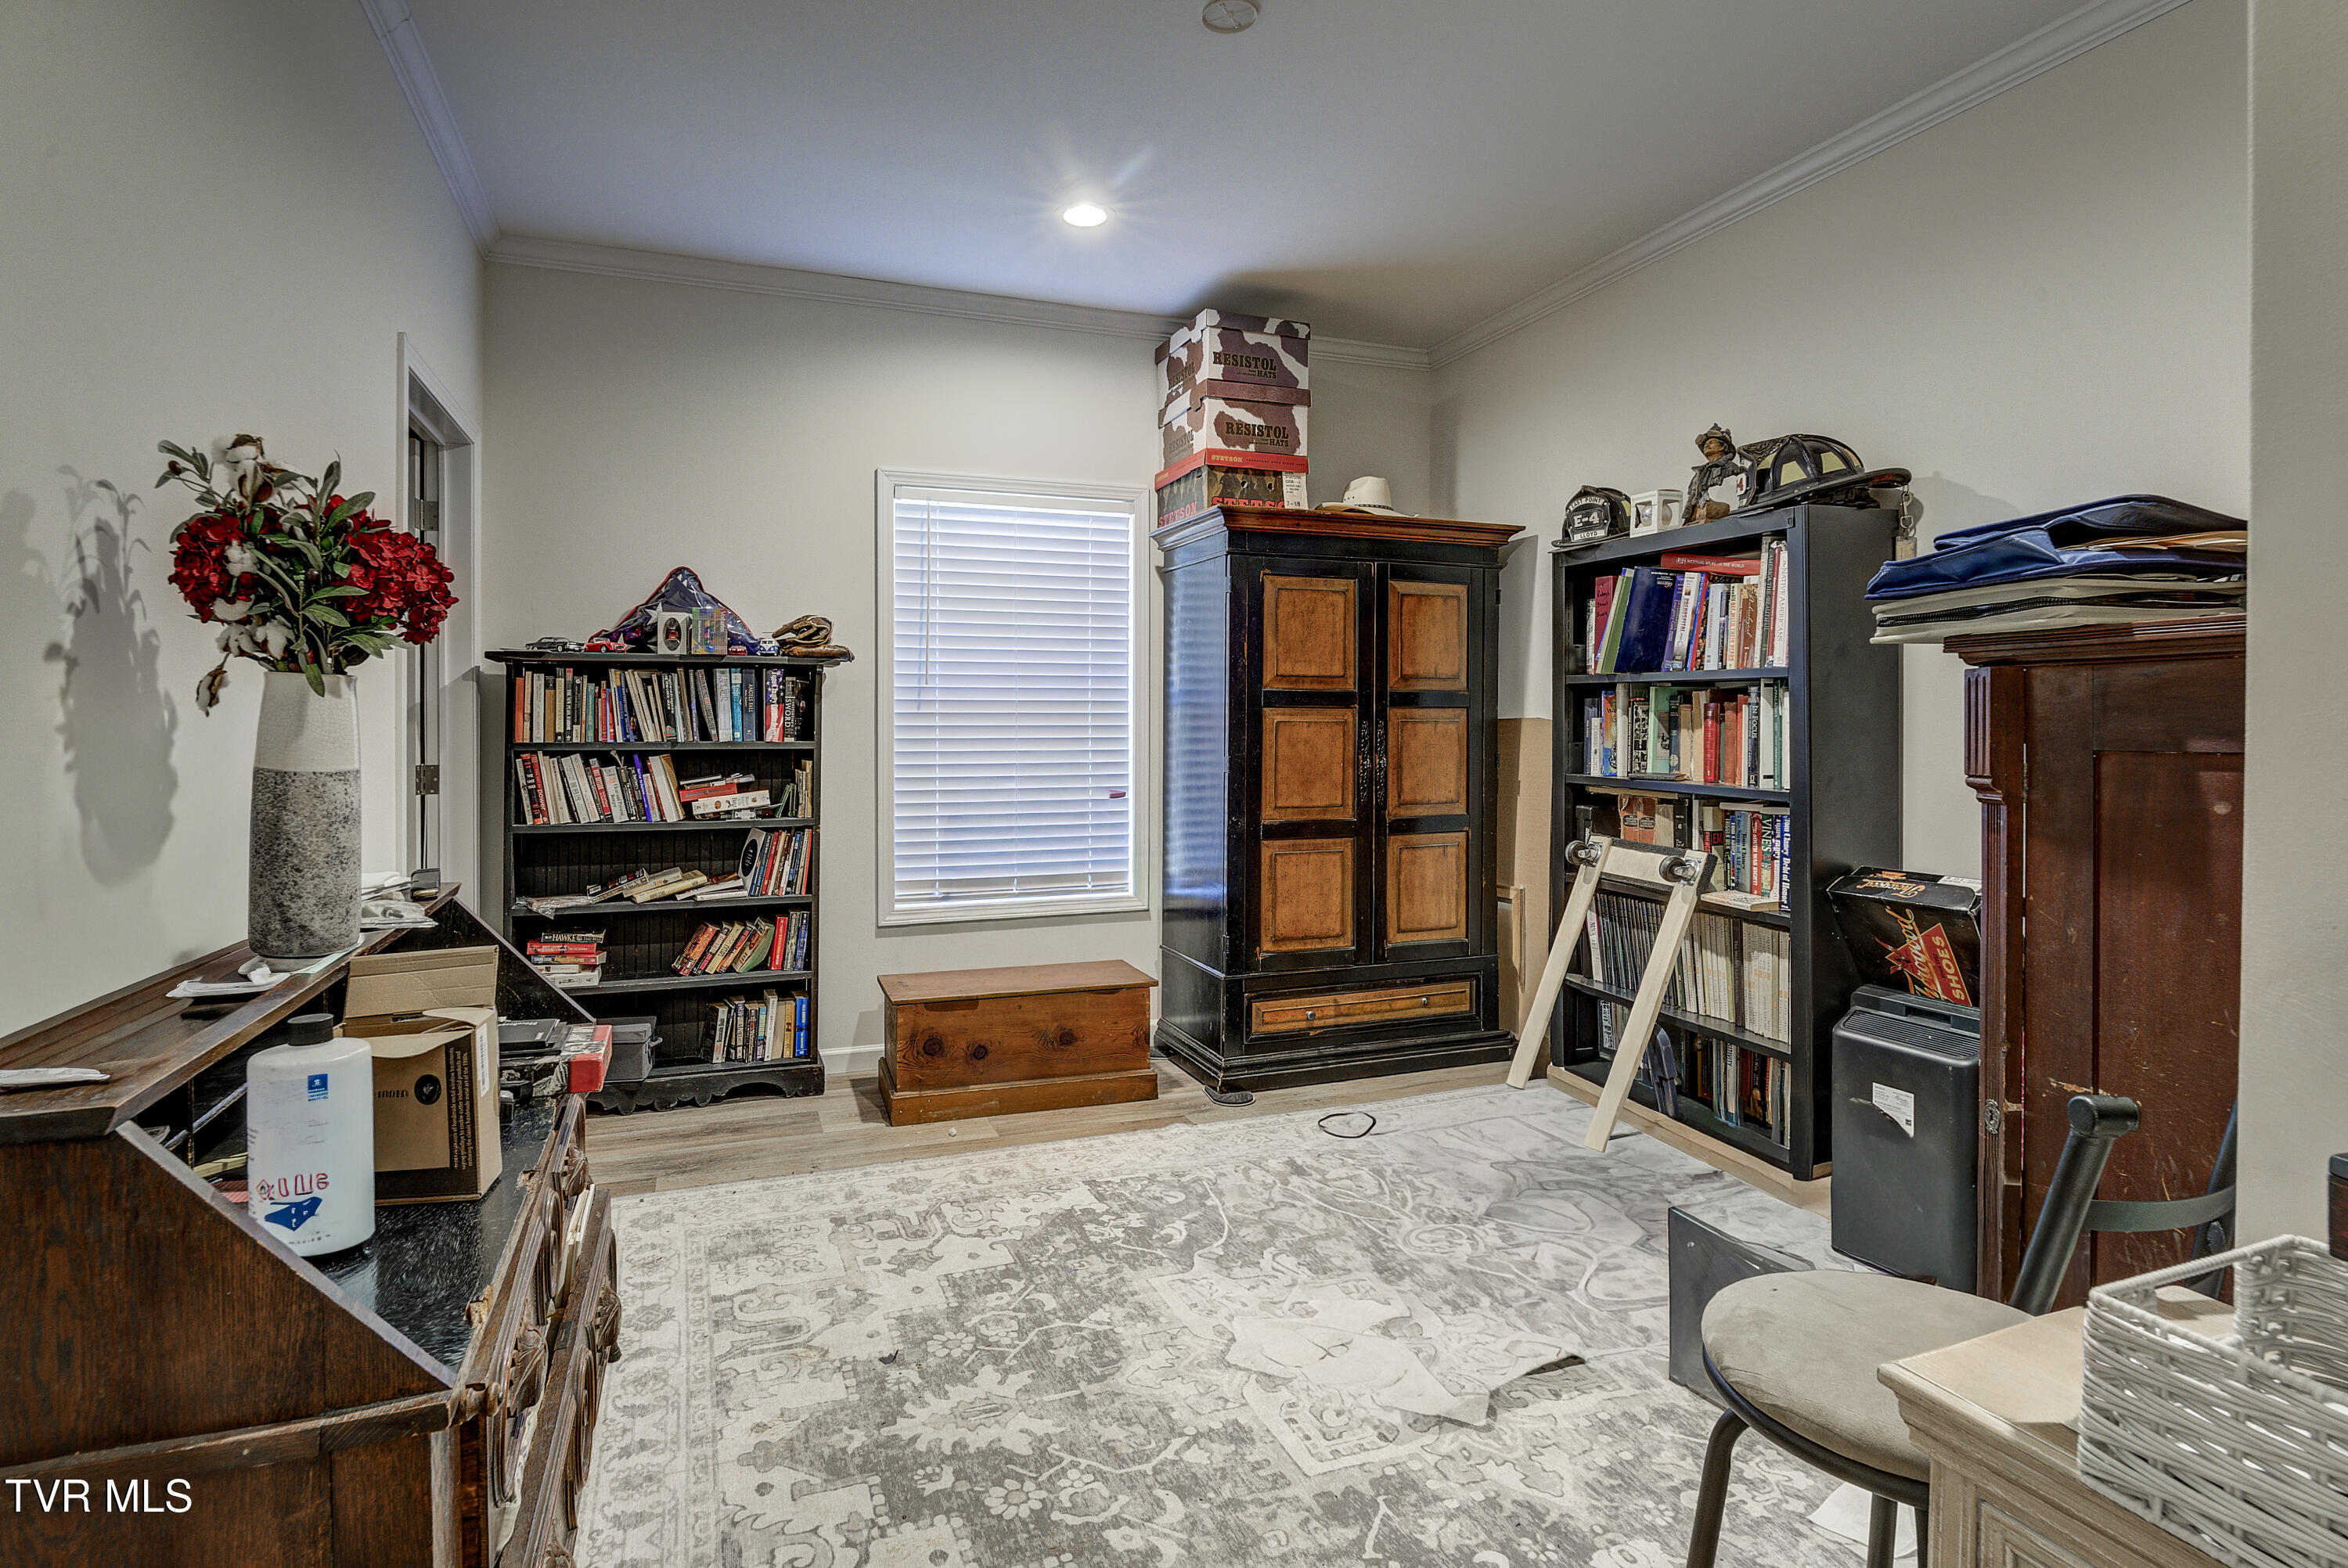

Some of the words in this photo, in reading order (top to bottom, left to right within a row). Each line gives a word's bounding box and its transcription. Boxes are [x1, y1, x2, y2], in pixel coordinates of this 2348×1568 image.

[1212, 351, 1277, 372] RESISTOL
[1168, 361, 1195, 390] RESISTOL
[1256, 370, 1277, 379] HATS
[1169, 429, 1194, 453] RESISTOL
[1225, 421, 1289, 440] RESISTOL
[1269, 438, 1289, 447] HATS
[1158, 501, 1197, 528] STETSON
[1572, 499, 1584, 509] EAST
[1573, 512, 1600, 527] E-4
[1777, 597, 1786, 642] AMERICANS
[1752, 705, 1759, 714] IN
[537, 789, 546, 811] power
[1762, 818, 1772, 852] VINE'S
[1781, 833, 1791, 856] Clancy
[1781, 881, 1790, 904] Honor
[552, 933, 576, 942] HAWKE
[1885, 906, 1944, 1000] Thorogood
[1932, 936, 1965, 1001] SHOES
